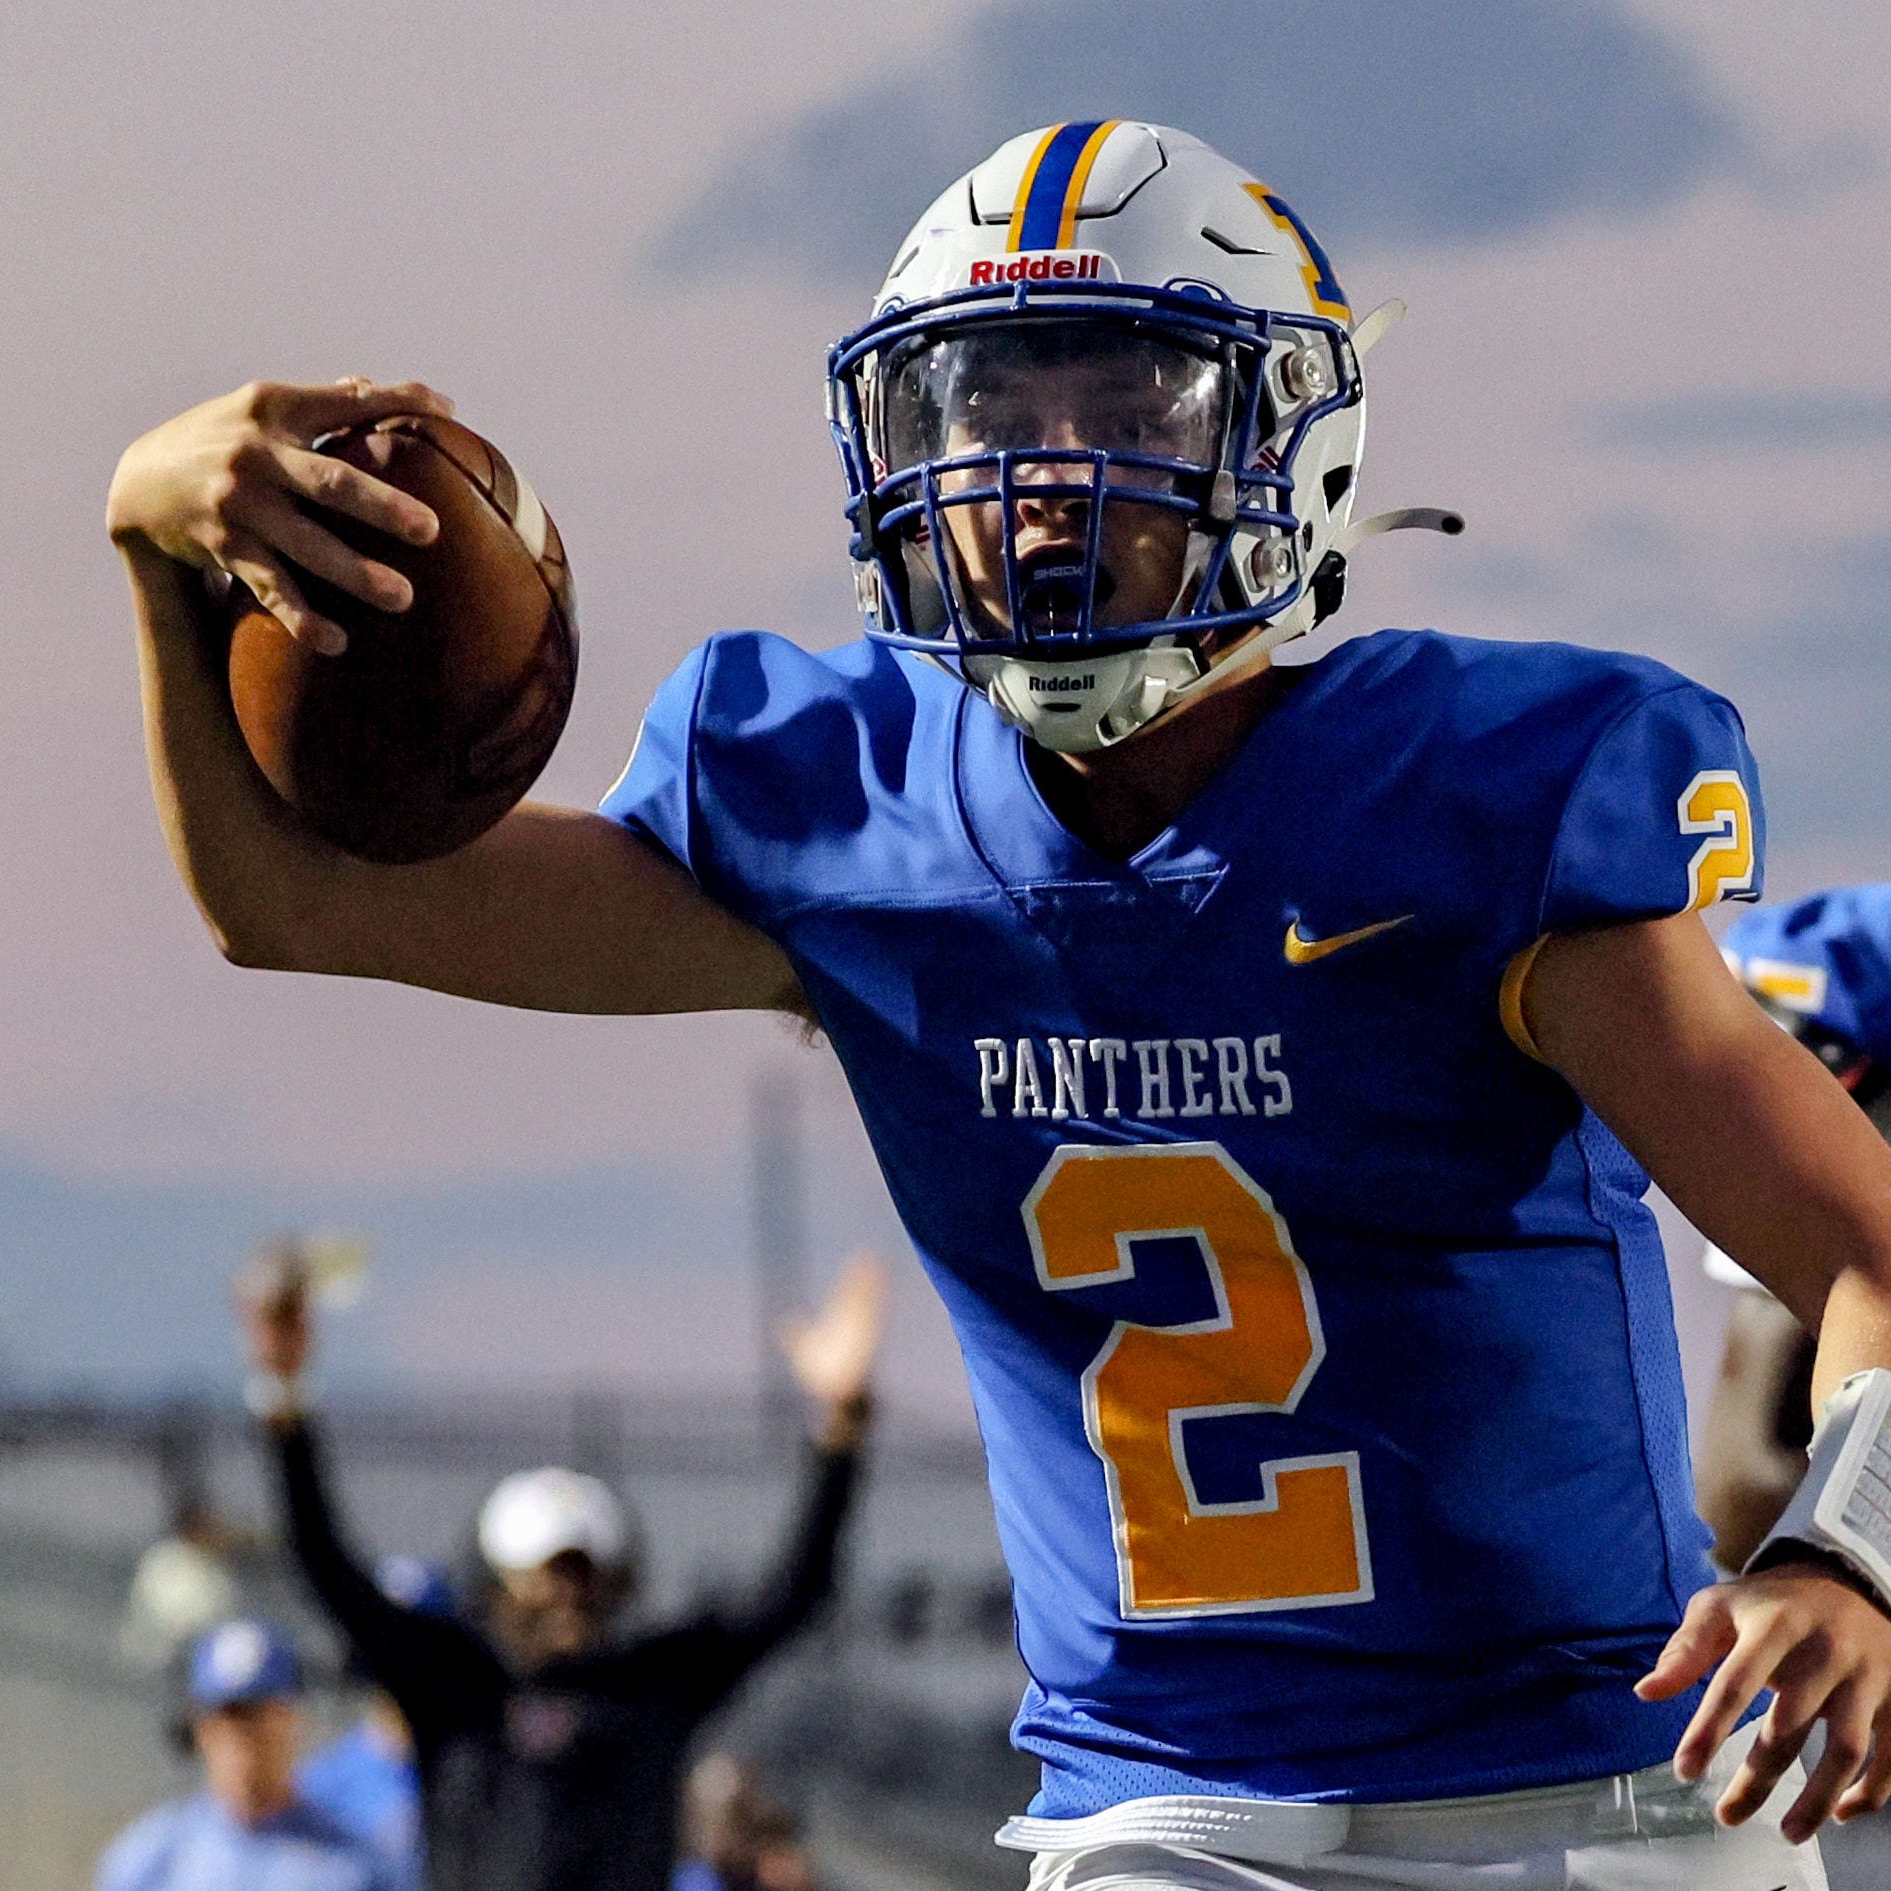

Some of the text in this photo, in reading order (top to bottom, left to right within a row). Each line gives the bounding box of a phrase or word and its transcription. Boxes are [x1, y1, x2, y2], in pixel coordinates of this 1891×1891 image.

[970, 255, 1101, 286] Riddell
[1029, 674, 1095, 692] Riddell
[1677, 770, 1755, 916] 2
[974, 1032, 1293, 1120] PANTHERS
[1021, 1140, 1376, 1620] 2
